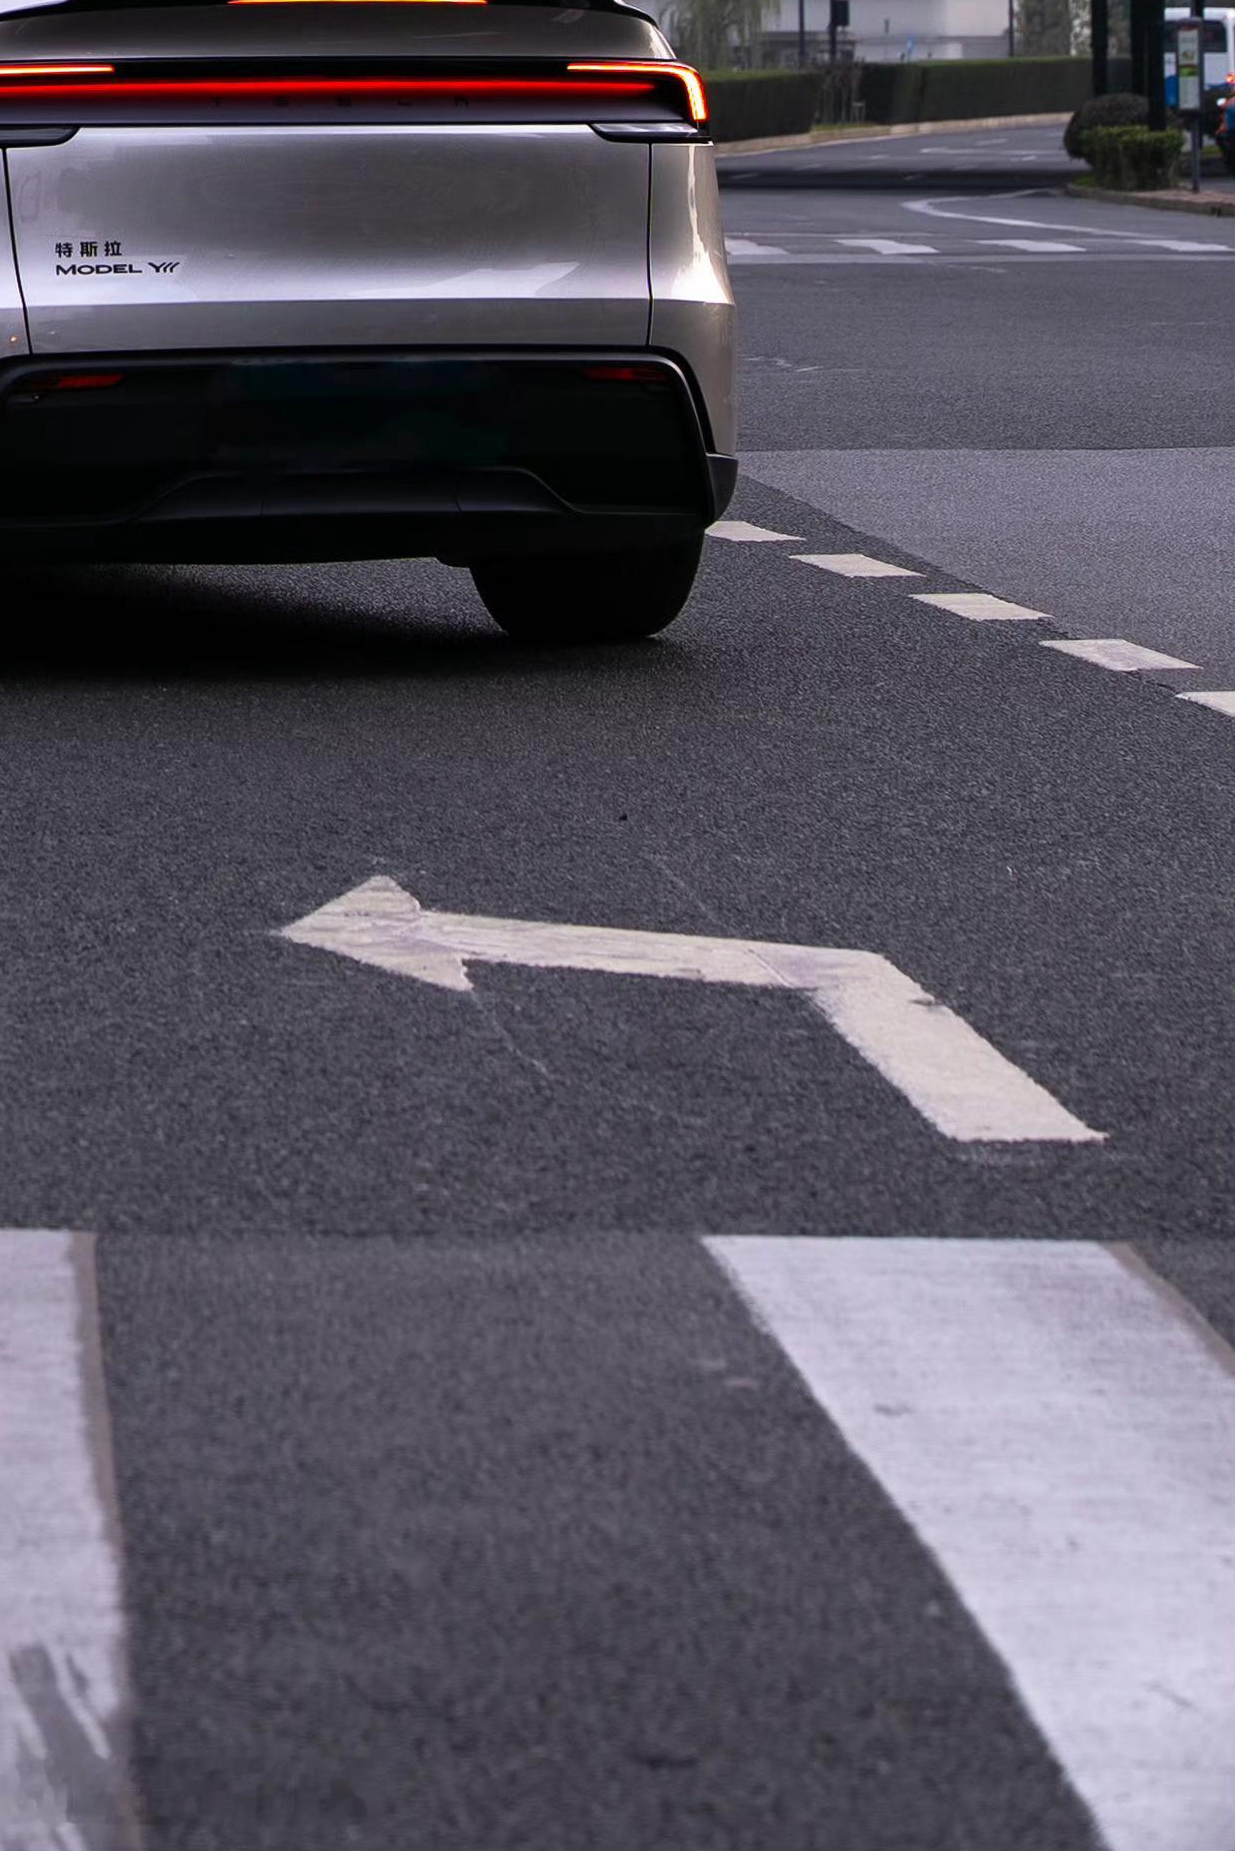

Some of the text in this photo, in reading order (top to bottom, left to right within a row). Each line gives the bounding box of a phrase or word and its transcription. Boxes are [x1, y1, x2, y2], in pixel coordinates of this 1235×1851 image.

[55, 240, 123, 258] 特斯拉
[56, 263, 143, 276] MODEL
